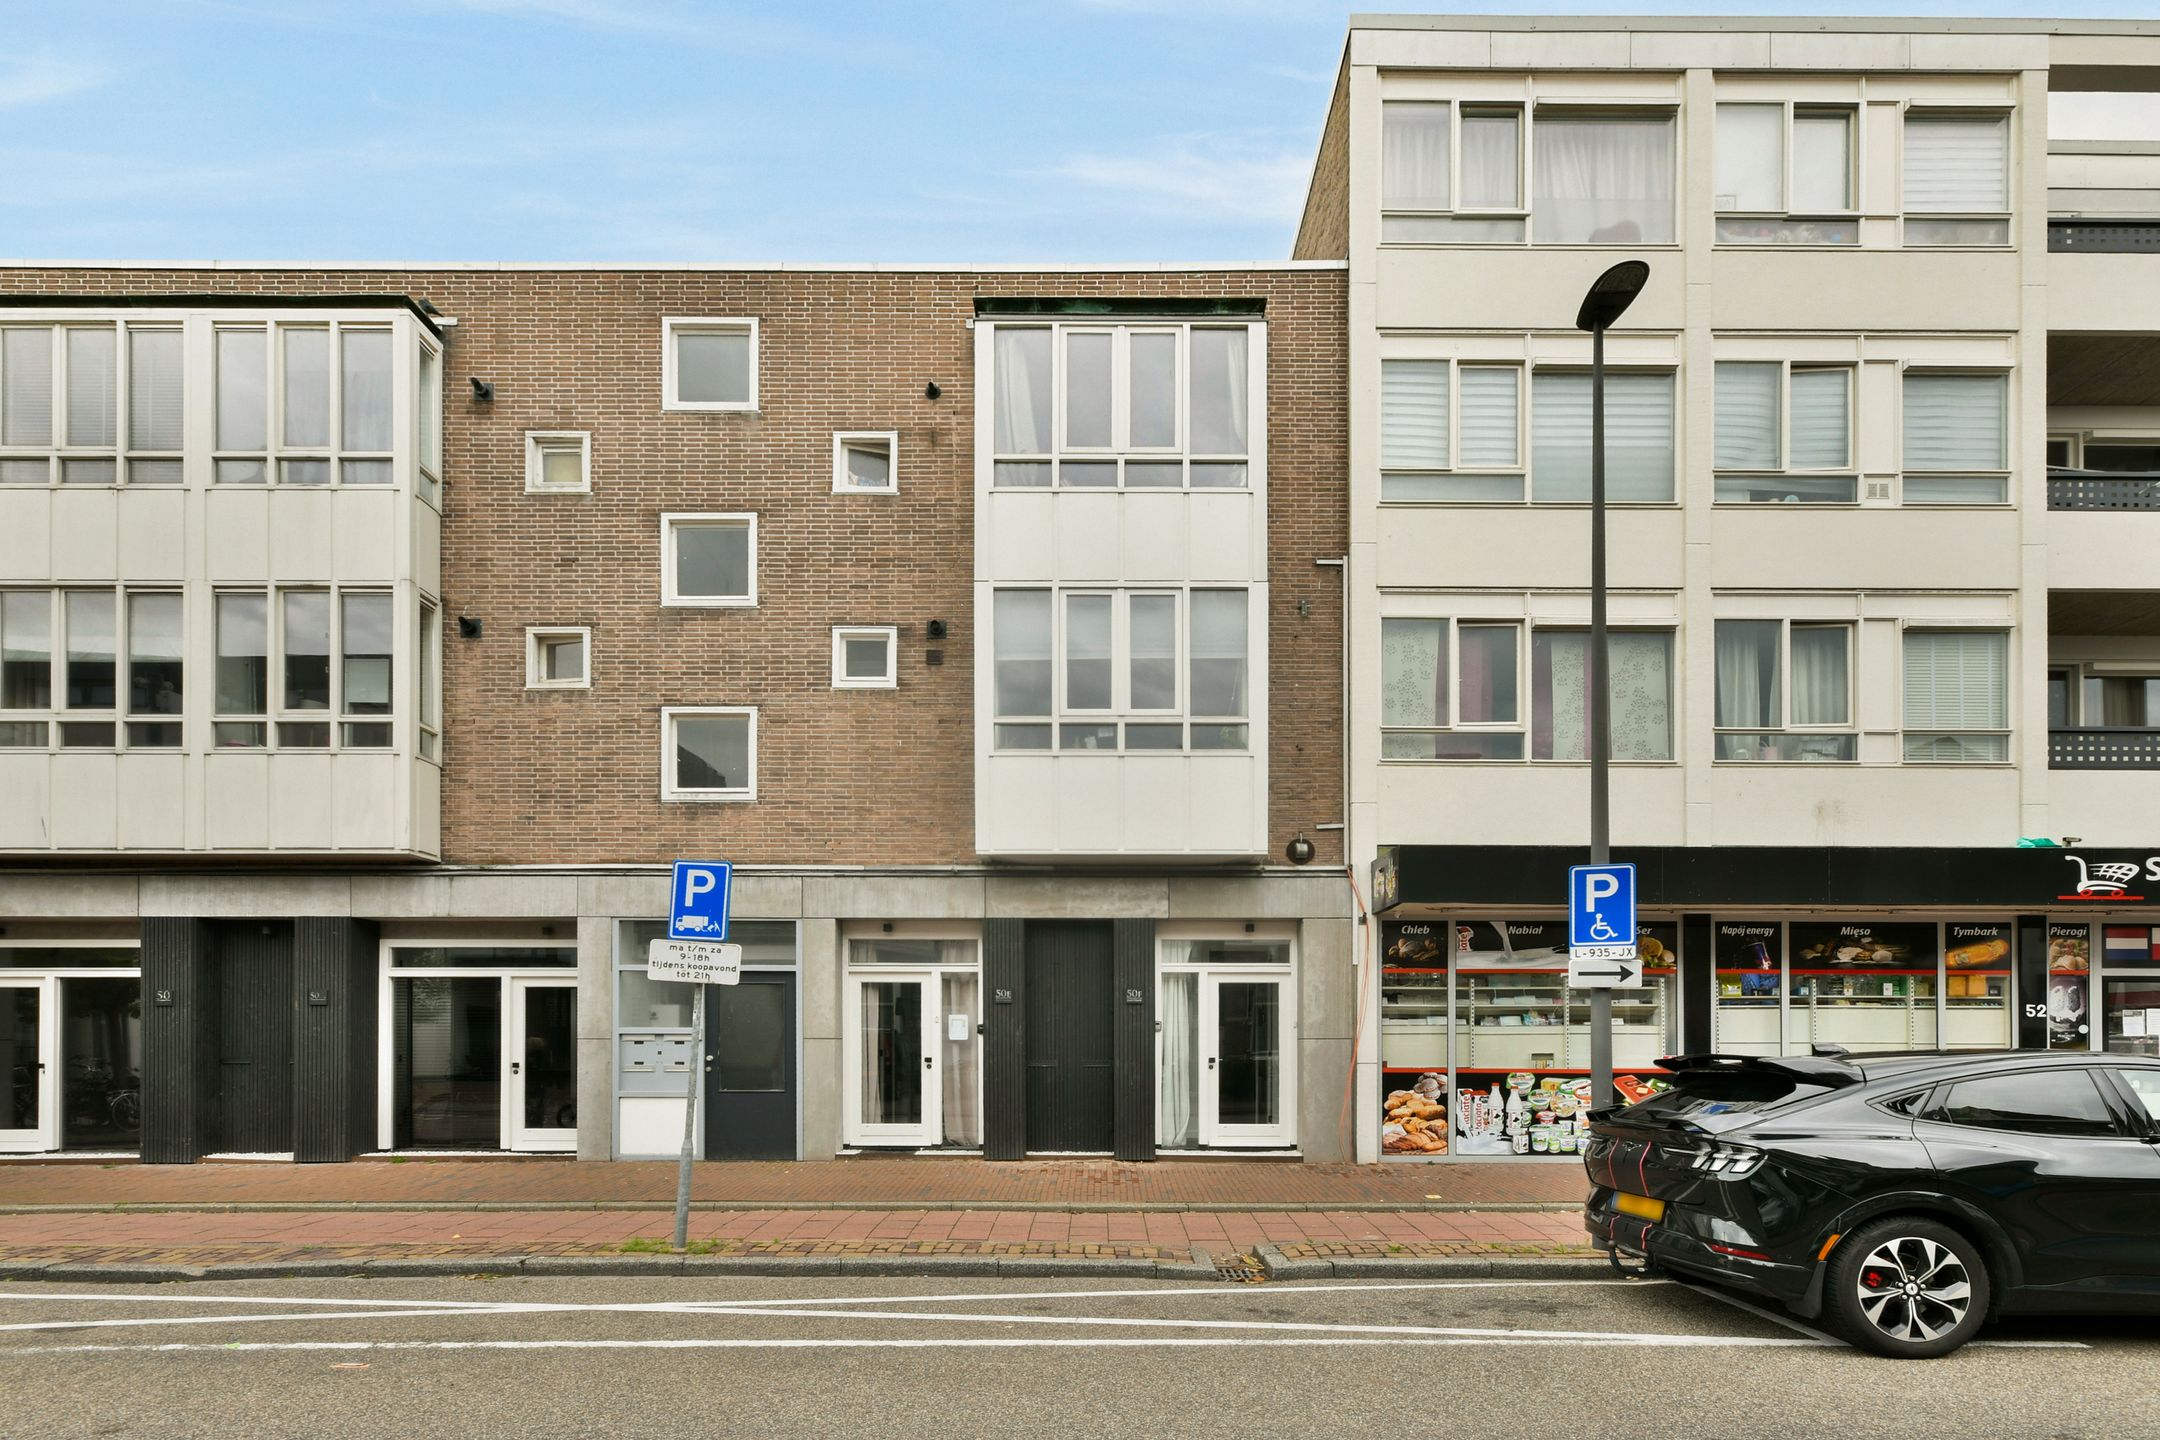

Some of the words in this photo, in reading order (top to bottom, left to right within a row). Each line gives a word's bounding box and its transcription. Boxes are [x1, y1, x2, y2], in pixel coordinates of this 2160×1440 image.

[685, 869, 716, 907] P
[1586, 873, 1619, 913] P
[1401, 924, 1430, 935] Chleb
[1508, 925, 1543, 935] Nabiał
[1721, 926, 1746, 937] Napój
[1746, 927, 1774, 937] energy
[1840, 926, 1871, 938] Mięso
[1953, 926, 1998, 938] Tymbark
[2050, 926, 2087, 937] Pierogi
[669, 944, 684, 952] ma
[688, 945, 707, 953] t/m
[1574, 947, 1633, 958] L-935-JX
[680, 953, 710, 961] 9-18h
[652, 961, 685, 970] tijdens
[687, 963, 737, 973] koopavond
[694, 971, 711, 980] 21h
[2025, 1004, 2047, 1018] 52
